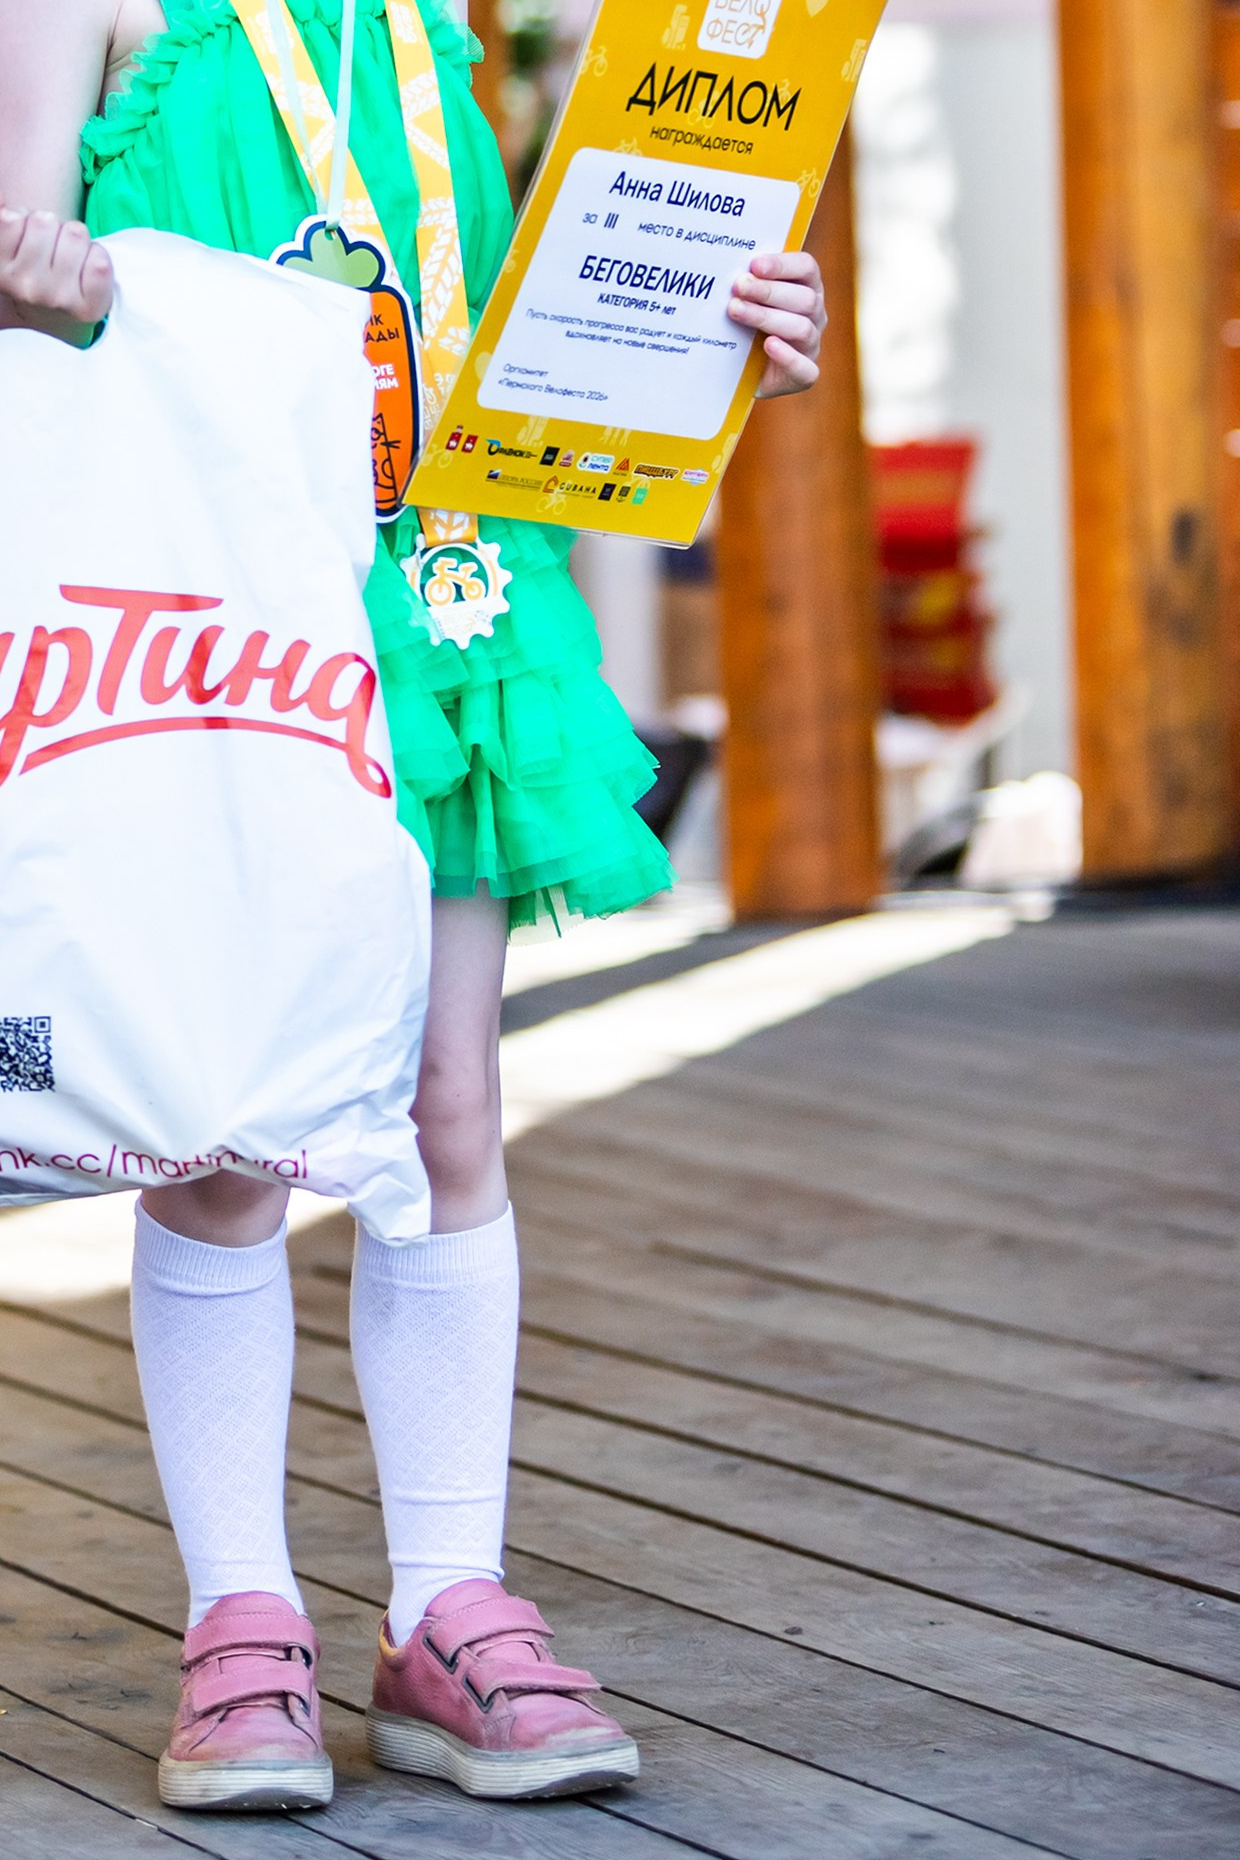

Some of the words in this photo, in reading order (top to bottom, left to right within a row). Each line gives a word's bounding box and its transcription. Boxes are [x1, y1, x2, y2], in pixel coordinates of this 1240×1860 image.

[625, 62, 802, 131] ДИПЛОМ
[649, 126, 754, 155] награждается
[609, 171, 663, 201] Анна
[666, 180, 746, 217] Шилова
[582, 213, 598, 225] за
[637, 222, 674, 237] место
[675, 228, 684, 238] в
[684, 230, 757, 250] дисциплине
[578, 255, 716, 300] БЕГОВЕЛИКИ
[597, 293, 649, 311] КАТЕГОРИЯ
[649, 302, 661, 312] 5+
[662, 306, 677, 315] лет
[526, 308, 548, 320] Пусть
[549, 314, 584, 326] скорость
[585, 319, 624, 332] прогресса
[640, 328, 666, 339] радует
[673, 333, 702, 344] каждый
[703, 338, 737, 350] километр
[565, 330, 612, 343] вдохновляет
[624, 339, 646, 349] новые
[647, 342, 690, 354] свершения!
